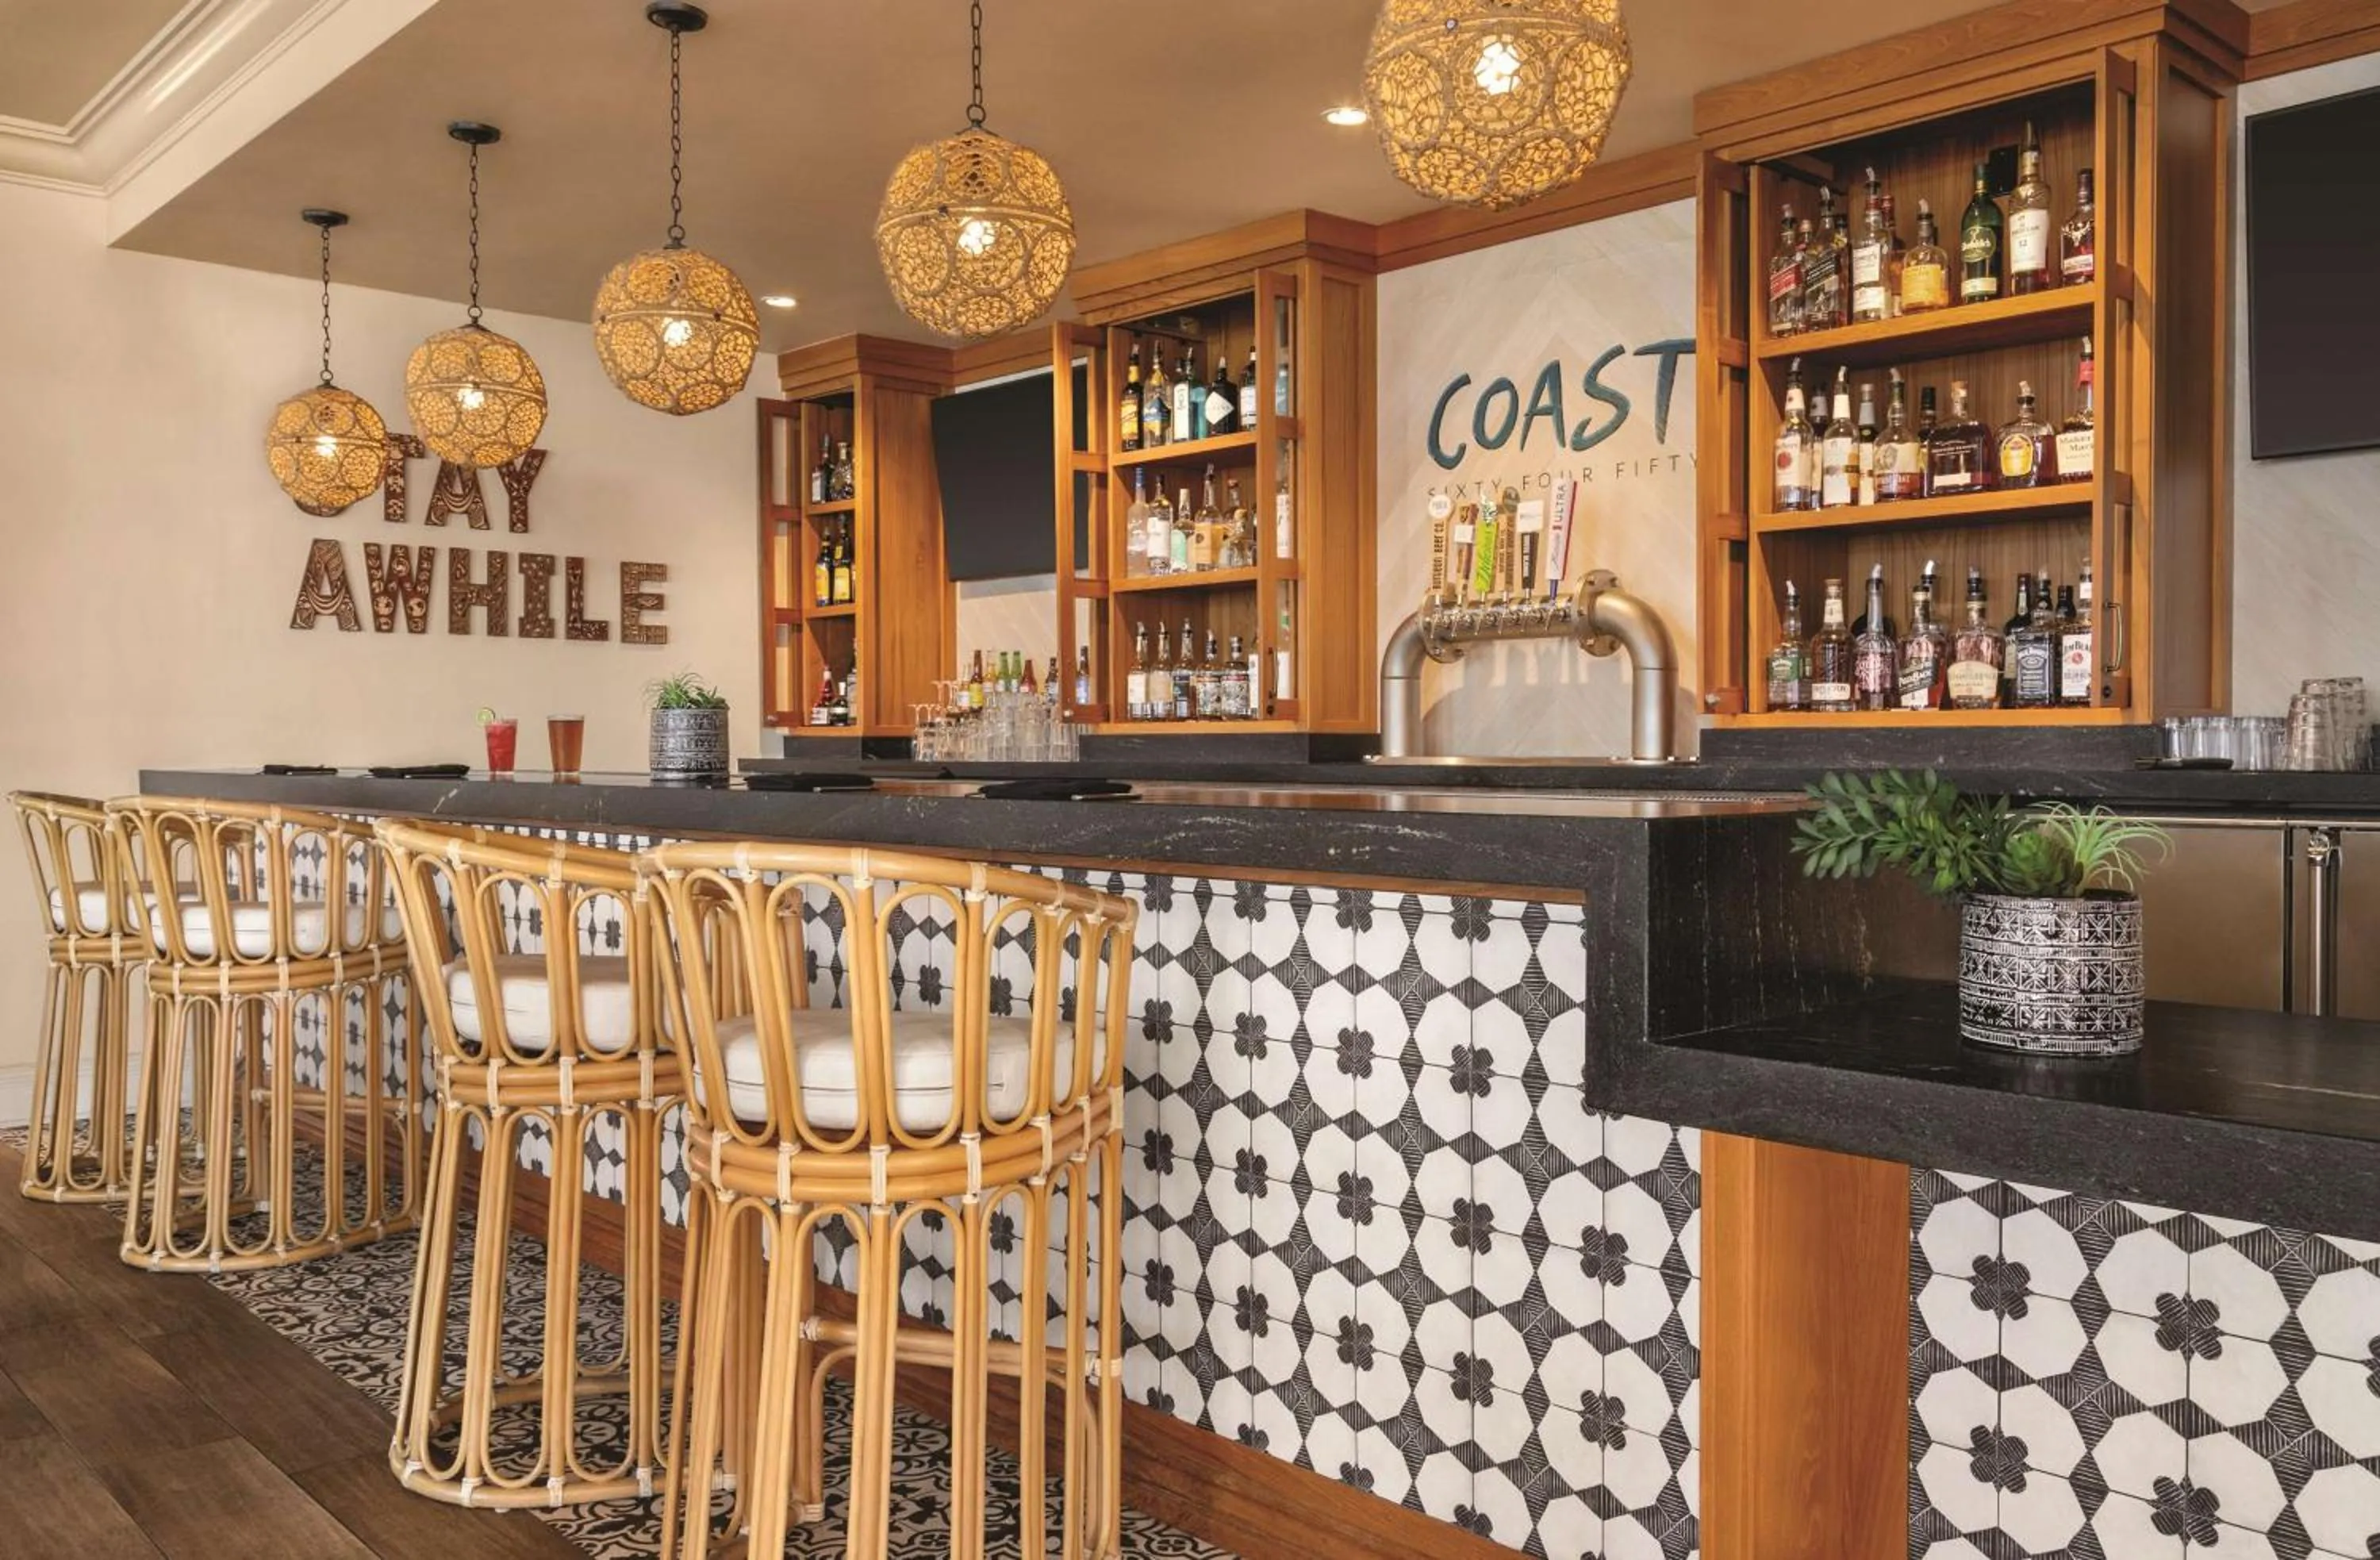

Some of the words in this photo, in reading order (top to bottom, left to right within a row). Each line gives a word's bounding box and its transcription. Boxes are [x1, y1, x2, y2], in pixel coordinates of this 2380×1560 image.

[1427, 339, 1696, 471] COAST
[294, 433, 547, 533] TAY
[1554, 486, 1567, 522] ULTRA
[290, 538, 667, 644] AWHILE
